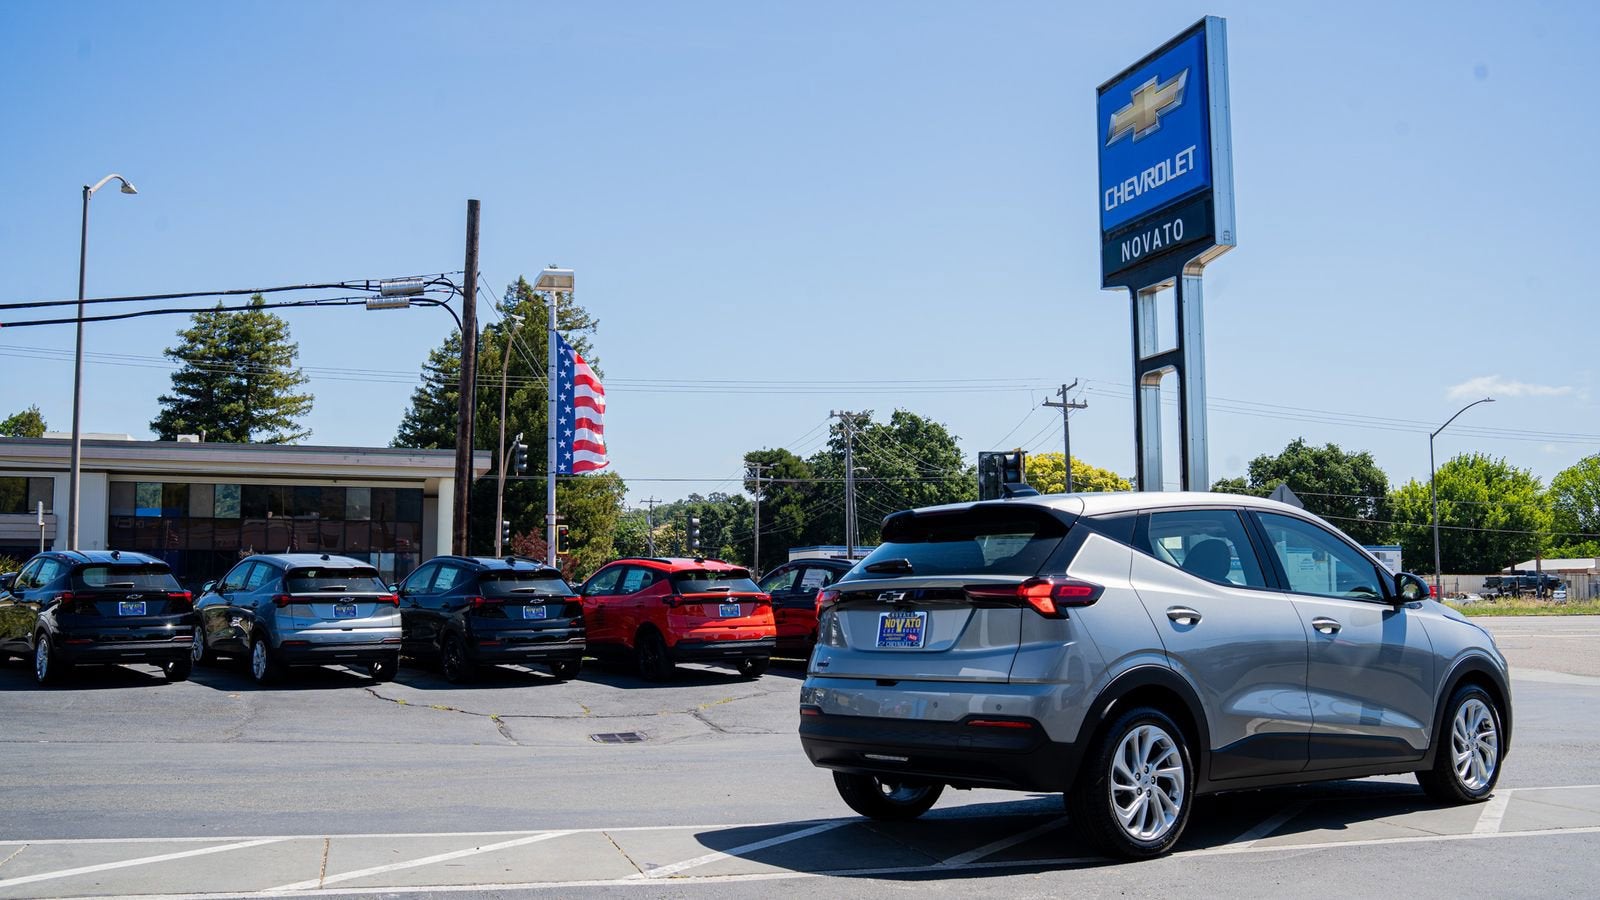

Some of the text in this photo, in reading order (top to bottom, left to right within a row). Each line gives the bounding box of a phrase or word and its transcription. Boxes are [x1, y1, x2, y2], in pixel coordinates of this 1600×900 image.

[1105, 145, 1196, 211] CHEVROLET
[1121, 218, 1184, 262] NOVATO
[885, 618, 921, 632] NOVATO
